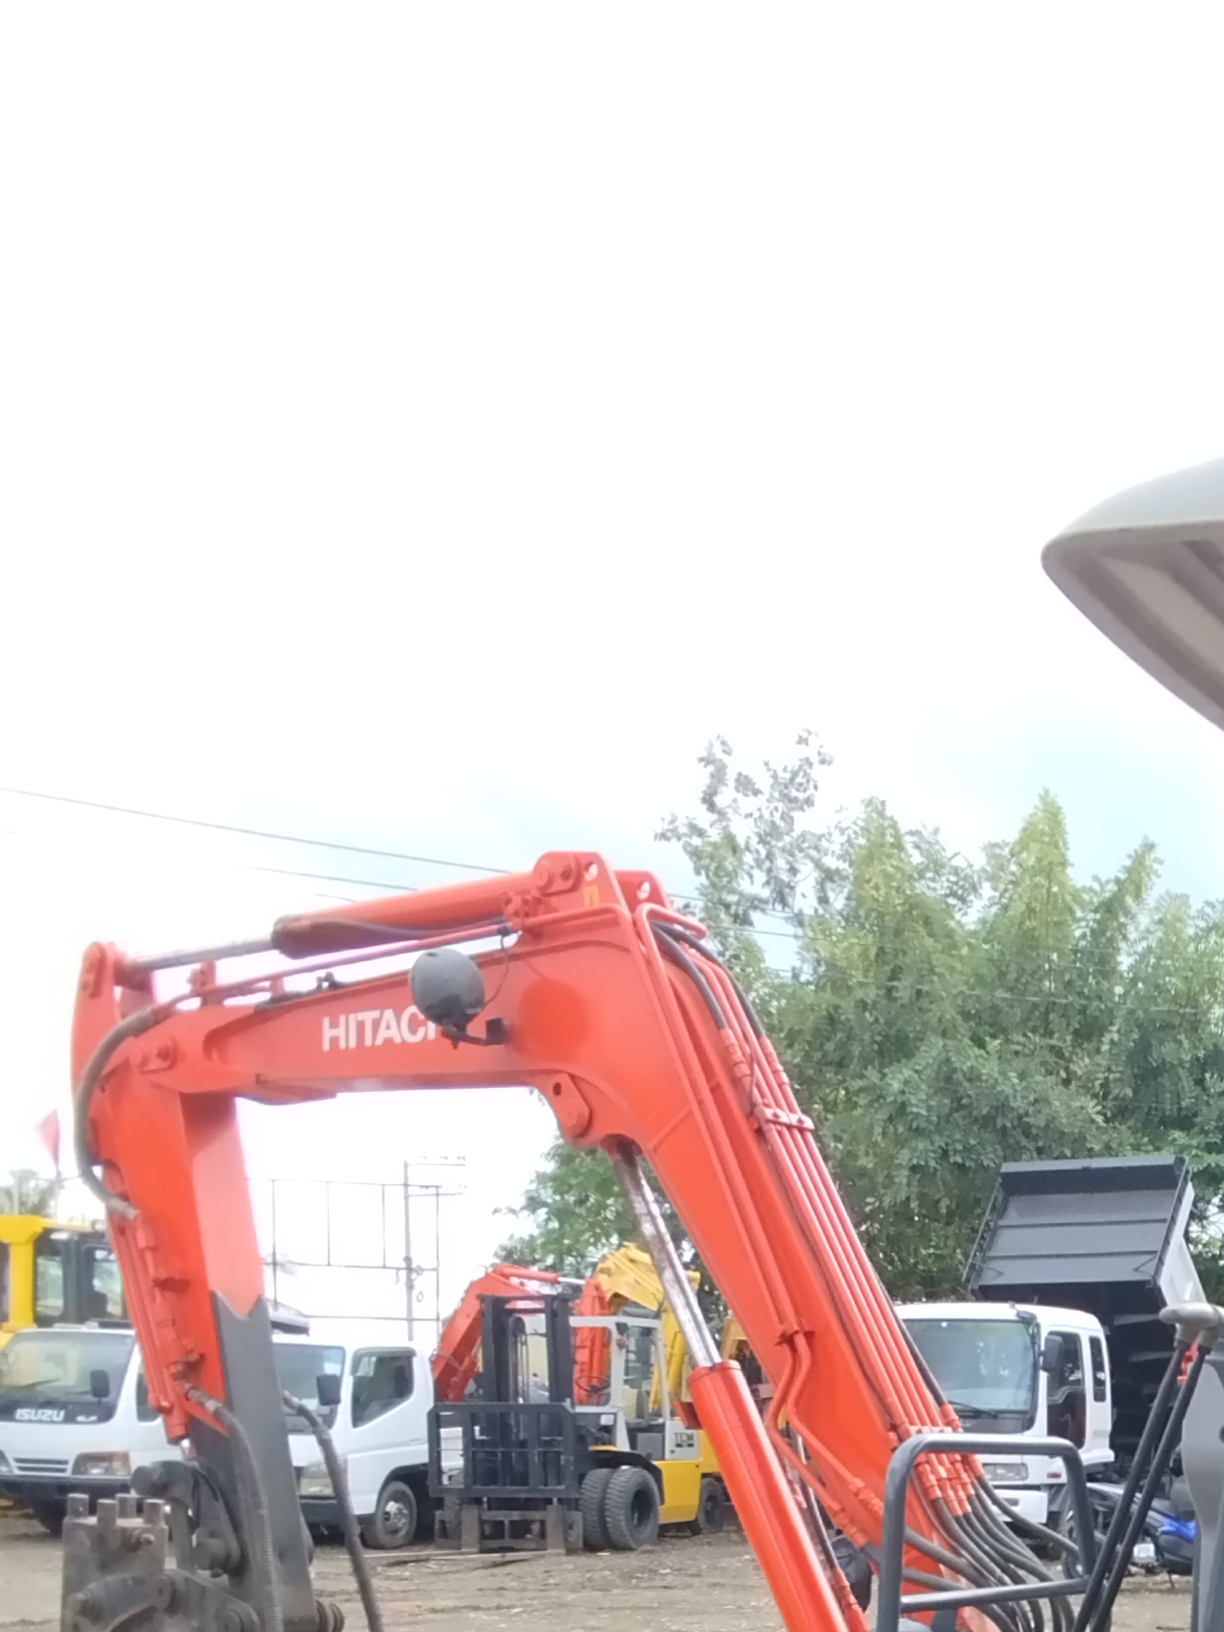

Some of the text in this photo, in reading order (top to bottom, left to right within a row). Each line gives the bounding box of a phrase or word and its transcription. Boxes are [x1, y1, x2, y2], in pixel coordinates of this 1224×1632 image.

[322, 1005, 437, 1052] HITAC
[15, 1408, 65, 1422] ISUZU
[673, 1432, 695, 1444] TCM
